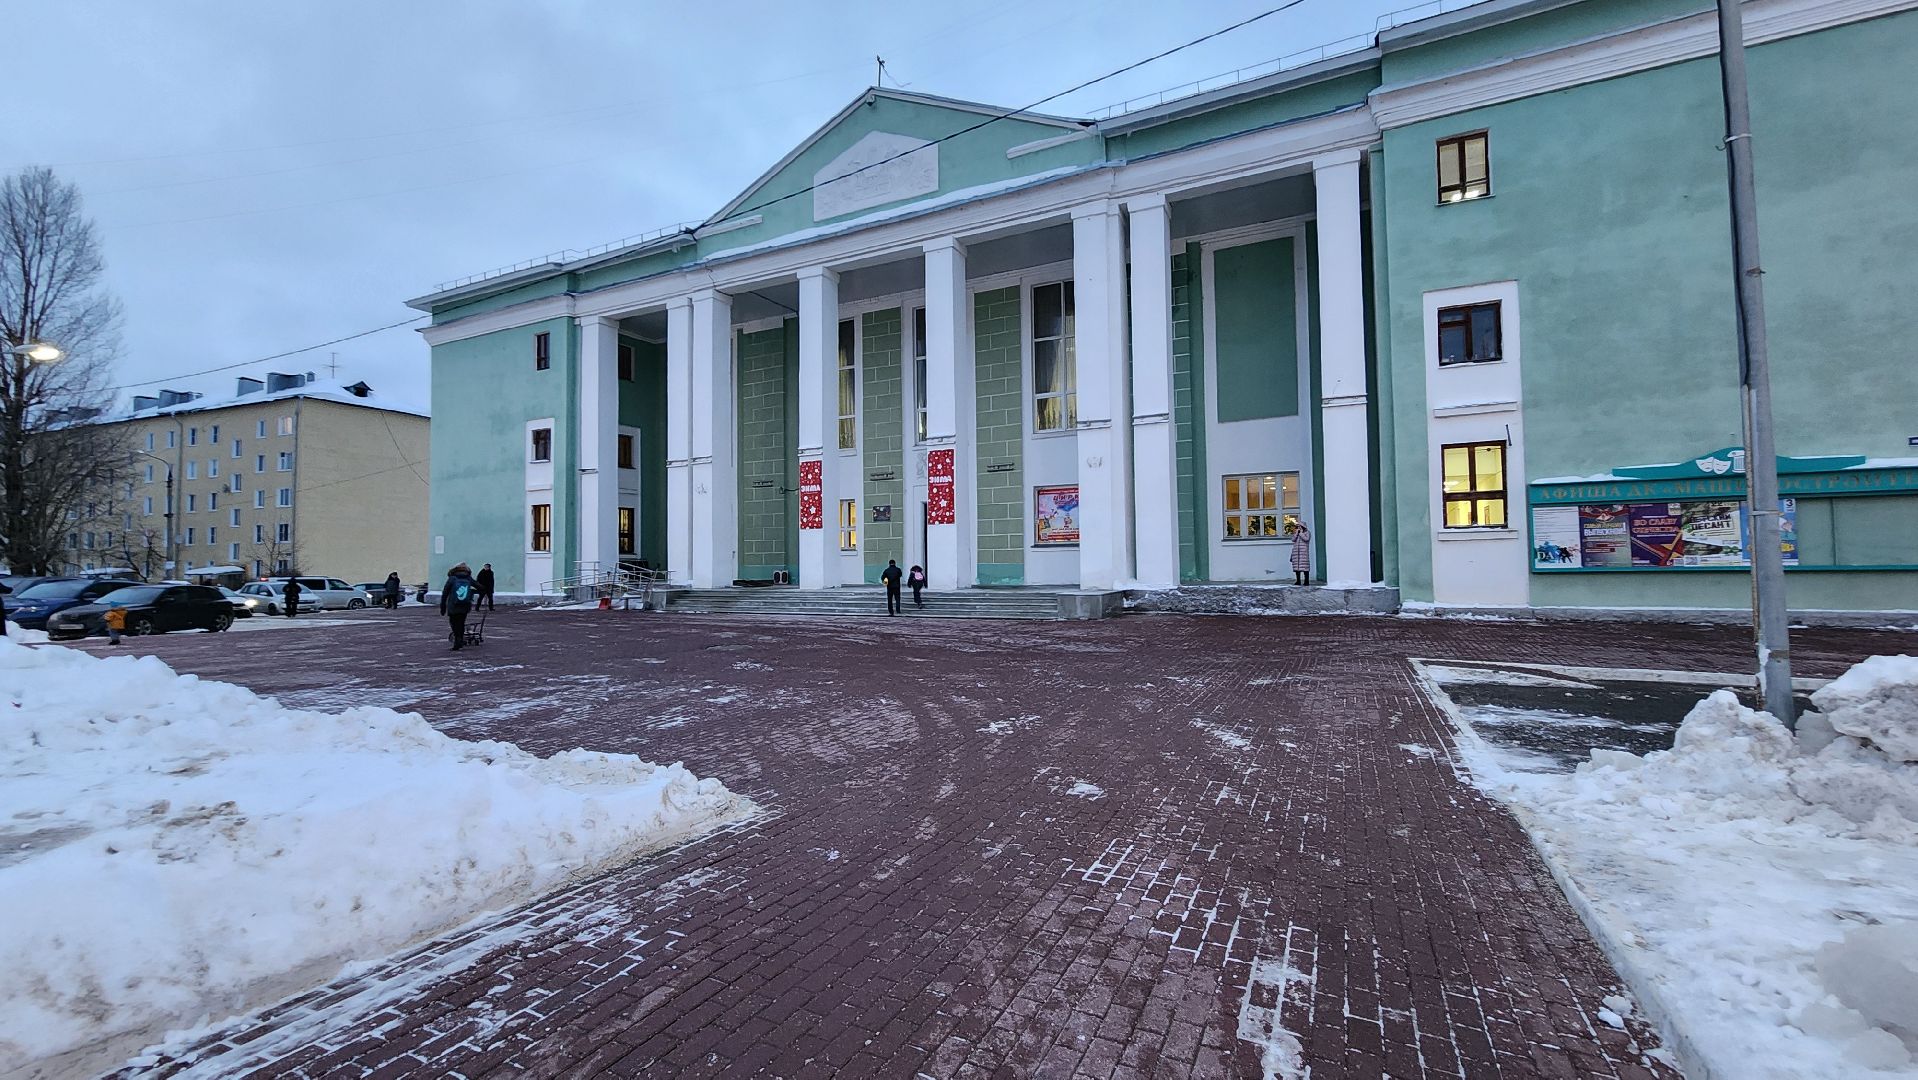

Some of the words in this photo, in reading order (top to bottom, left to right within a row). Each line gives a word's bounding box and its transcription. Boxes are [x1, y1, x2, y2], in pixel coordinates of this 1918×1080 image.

[929, 475, 953, 484] ЗИМА
[801, 484, 821, 493] ЗИМА
[1541, 484, 1621, 500] АФИША
[1627, 482, 1658, 497] ДК
[1691, 520, 1731, 530] ДЕСАНТ
